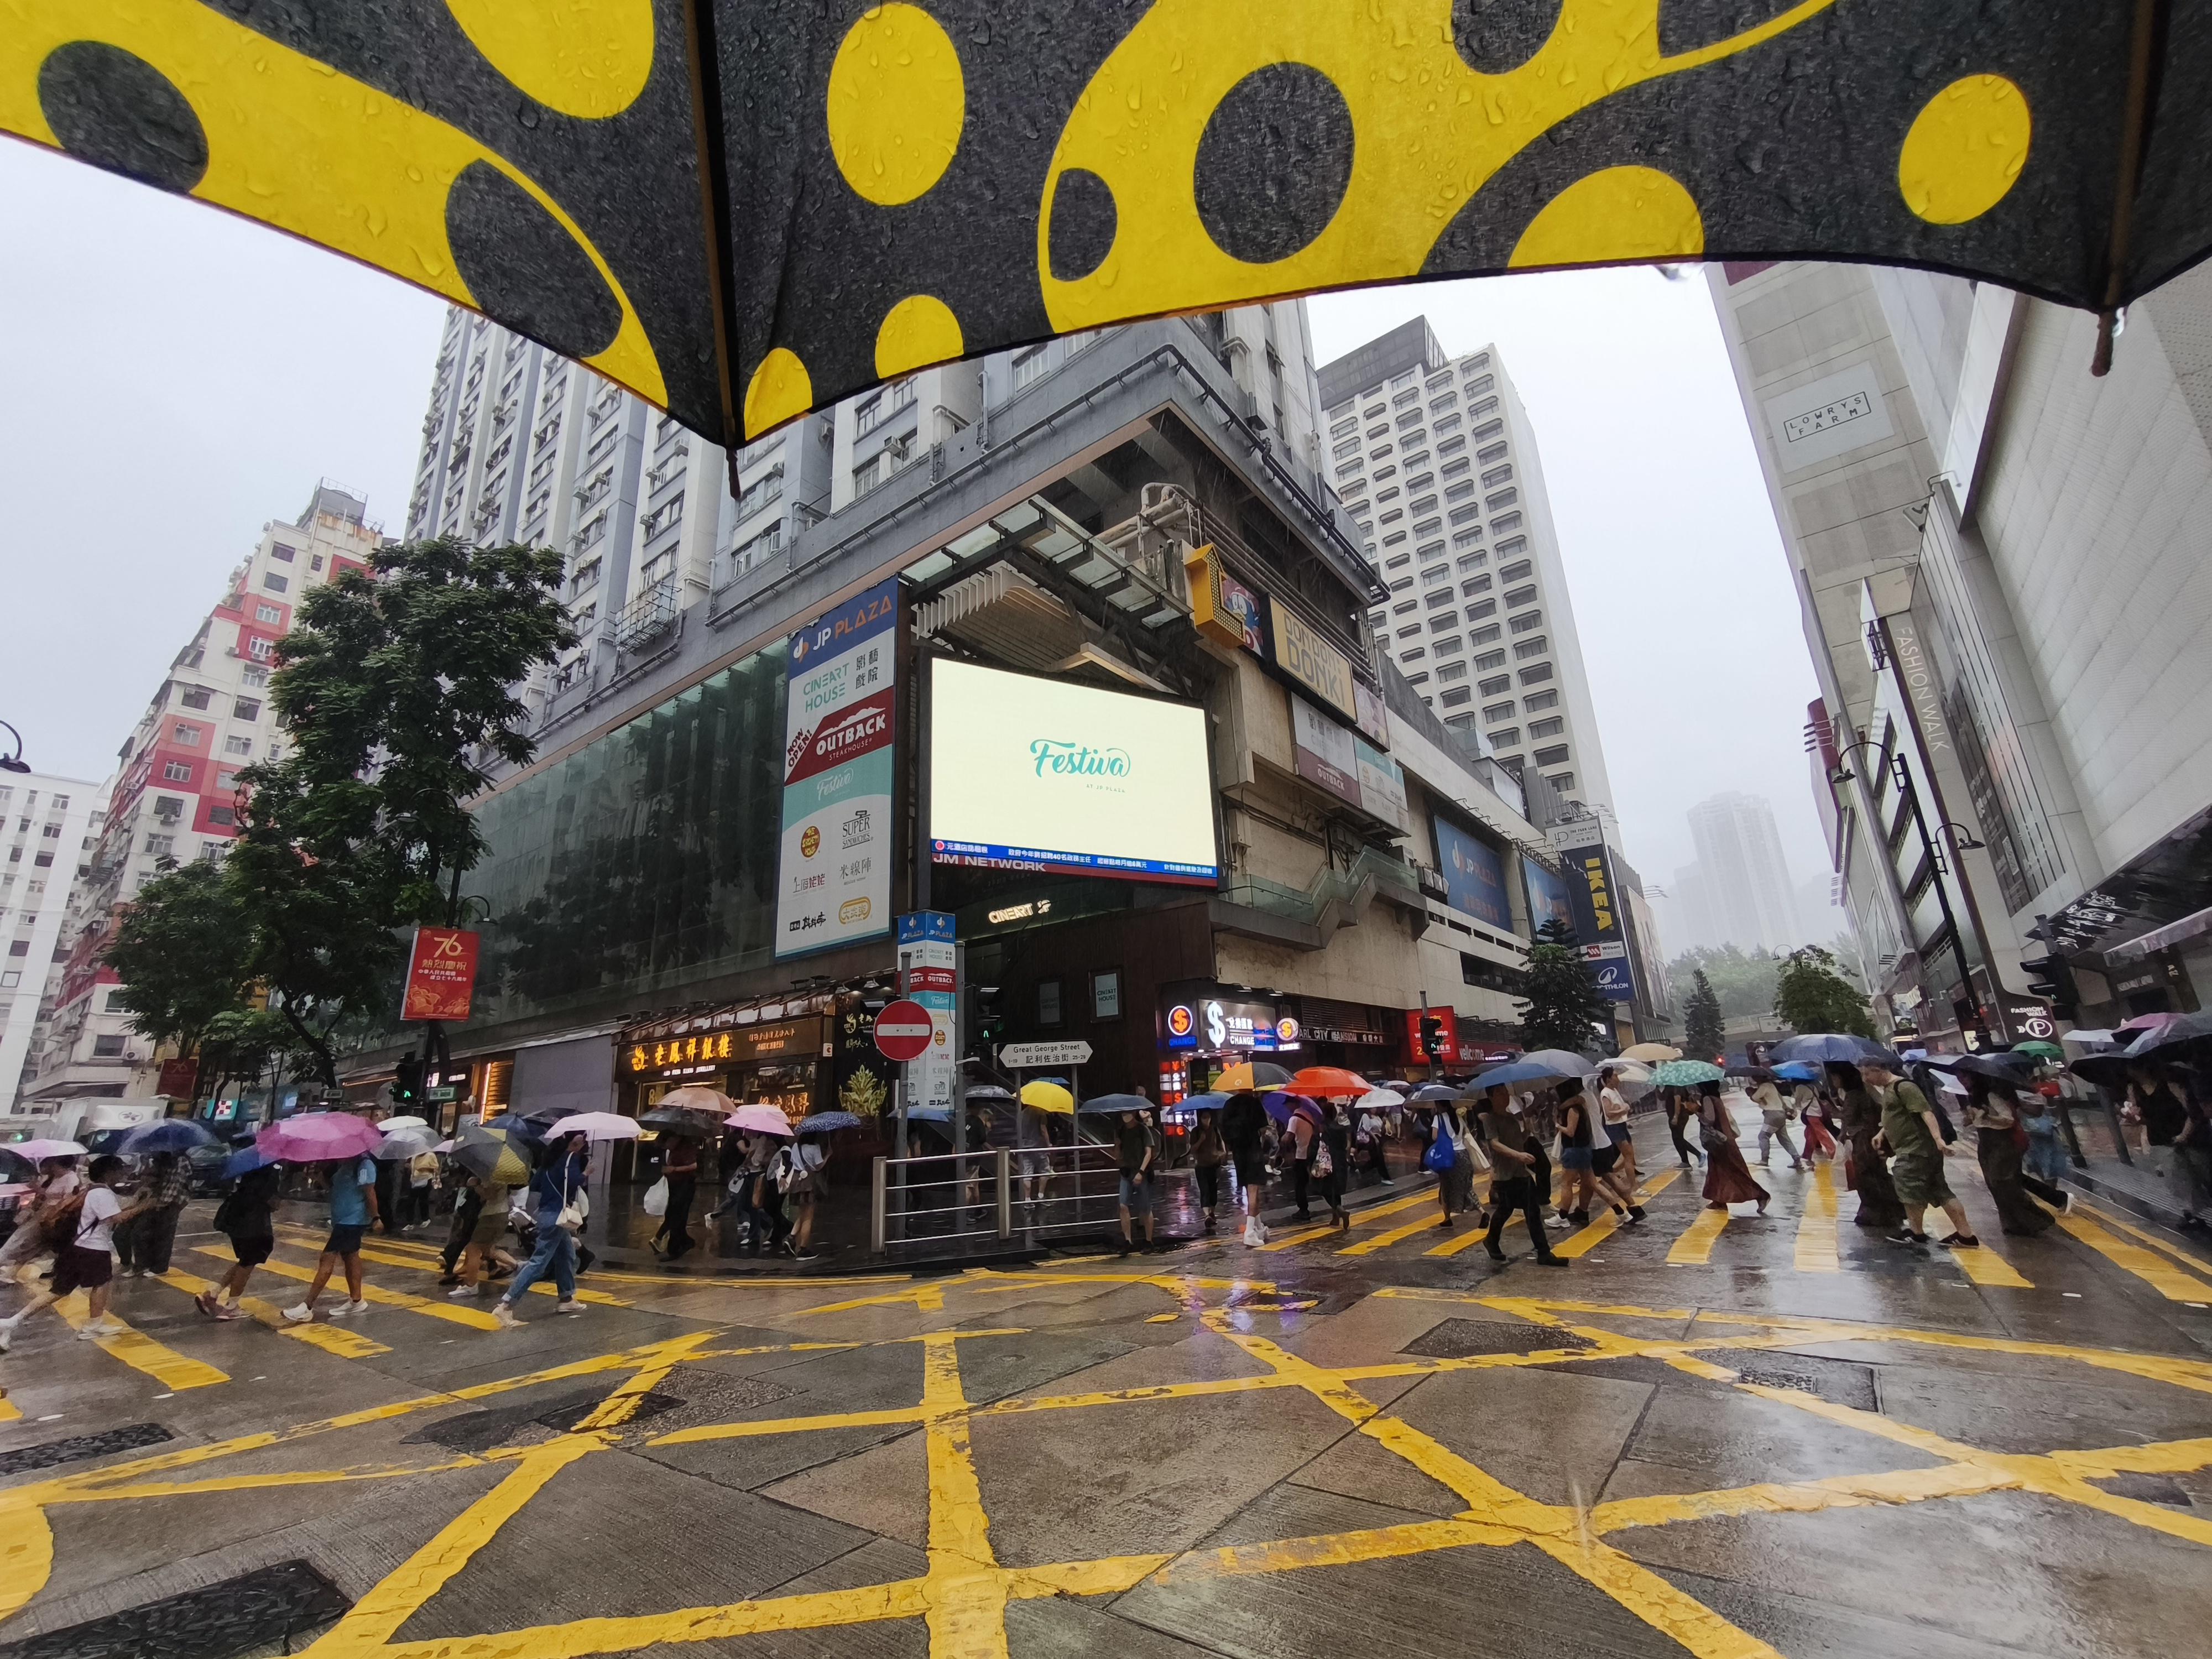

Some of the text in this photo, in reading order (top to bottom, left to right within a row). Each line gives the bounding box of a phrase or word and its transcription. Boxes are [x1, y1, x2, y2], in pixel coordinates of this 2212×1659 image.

[1790, 397, 1861, 429] LOWRYS
[1799, 408, 1858, 436] FARM
[813, 595, 893, 650] JP PLAZA
[1284, 612, 1311, 651] DON
[803, 662, 850, 696] CINEART
[1286, 635, 1345, 707] DONKI
[805, 682, 846, 713] HOUSE
[1896, 626, 1950, 752] FASHION WALK
[786, 728, 804, 756] NOW
[787, 729, 813, 768] OPEN!
[816, 713, 886, 756] OUTBACK
[1030, 739, 1131, 778] Festiva
[816, 768, 854, 801] Festiva
[1317, 766, 1345, 791] OUTBACK
[842, 816, 870, 838] SUPER
[842, 833, 870, 848] SANDWICHES
[933, 853, 1047, 872] JM NETWORK
[1584, 857, 1613, 931] IKEA
[988, 902, 1034, 924] CINEART
[434, 933, 464, 958] 76
[1097, 988, 1116, 996] CINEART
[655, 1033, 730, 1066] 老鳳祥銀樓
[1168, 1036, 1196, 1046] CHANGE
[1229, 1035, 1255, 1045] CHANGE
[1313, 1029, 1328, 1041] CITY
[1025, 1053, 1069, 1064] 記利佐治街
